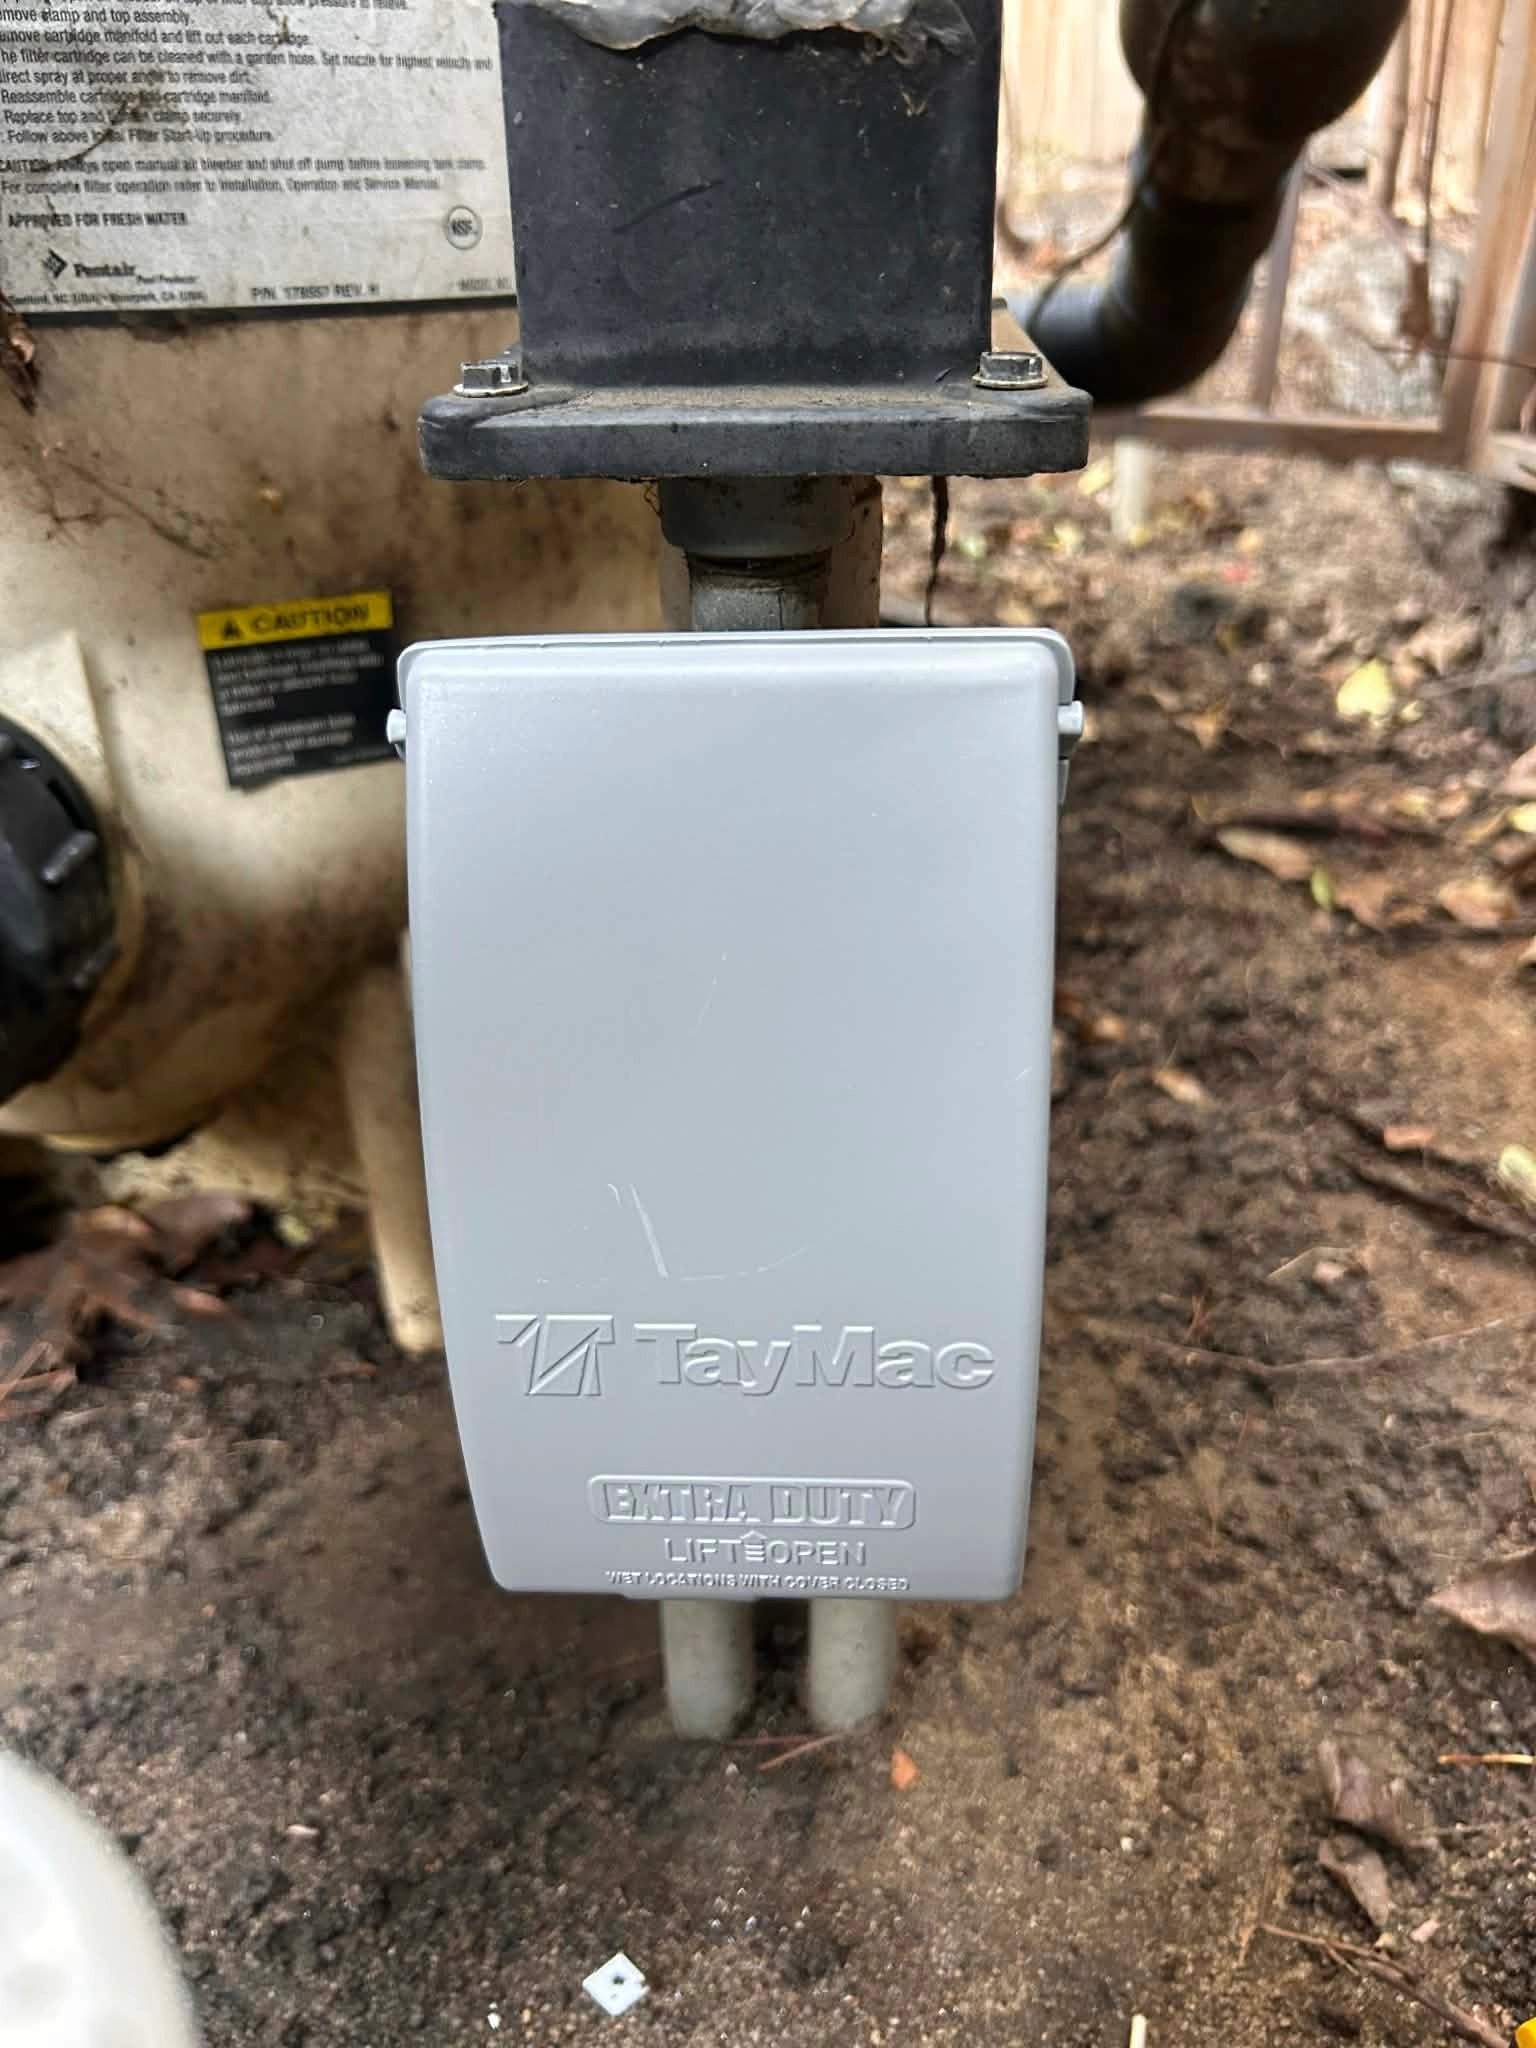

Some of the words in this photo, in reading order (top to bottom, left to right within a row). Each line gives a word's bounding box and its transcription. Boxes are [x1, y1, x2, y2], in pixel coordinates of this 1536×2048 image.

[42, 8, 80, 23] clamp
[83, 9, 107, 22] and
[110, 10, 130, 24] top
[161, 31, 182, 43] and
[205, 32, 225, 44] out
[227, 33, 256, 44] each
[20, 49, 48, 63] filter
[54, 50, 110, 66] cartridge
[113, 51, 136, 63] can
[139, 50, 155, 63] be
[34, 72, 68, 86] spray
[72, 70, 84, 83] at
[87, 72, 127, 86] proper
[167, 71, 180, 83] to
[2, 90, 77, 103] Reassemble
[4, 110, 55, 125] Replace
[52, 131, 88, 143] above
[75, 212, 100, 226] FOR
[252, 604, 369, 634] CAUTION
[634, 1322, 995, 1396] TayMac
[603, 1483, 761, 1522] EXTRA
[769, 1485, 911, 1526] DUTY
[663, 1537, 743, 1564] LIFT
[768, 1539, 867, 1567] OPEN
[605, 1570, 642, 1585] WET
[644, 1571, 738, 1588] LOCATIONS
[739, 1573, 782, 1588] WITH
[784, 1575, 841, 1589] COVER
[844, 1576, 911, 1592] CLOSED
